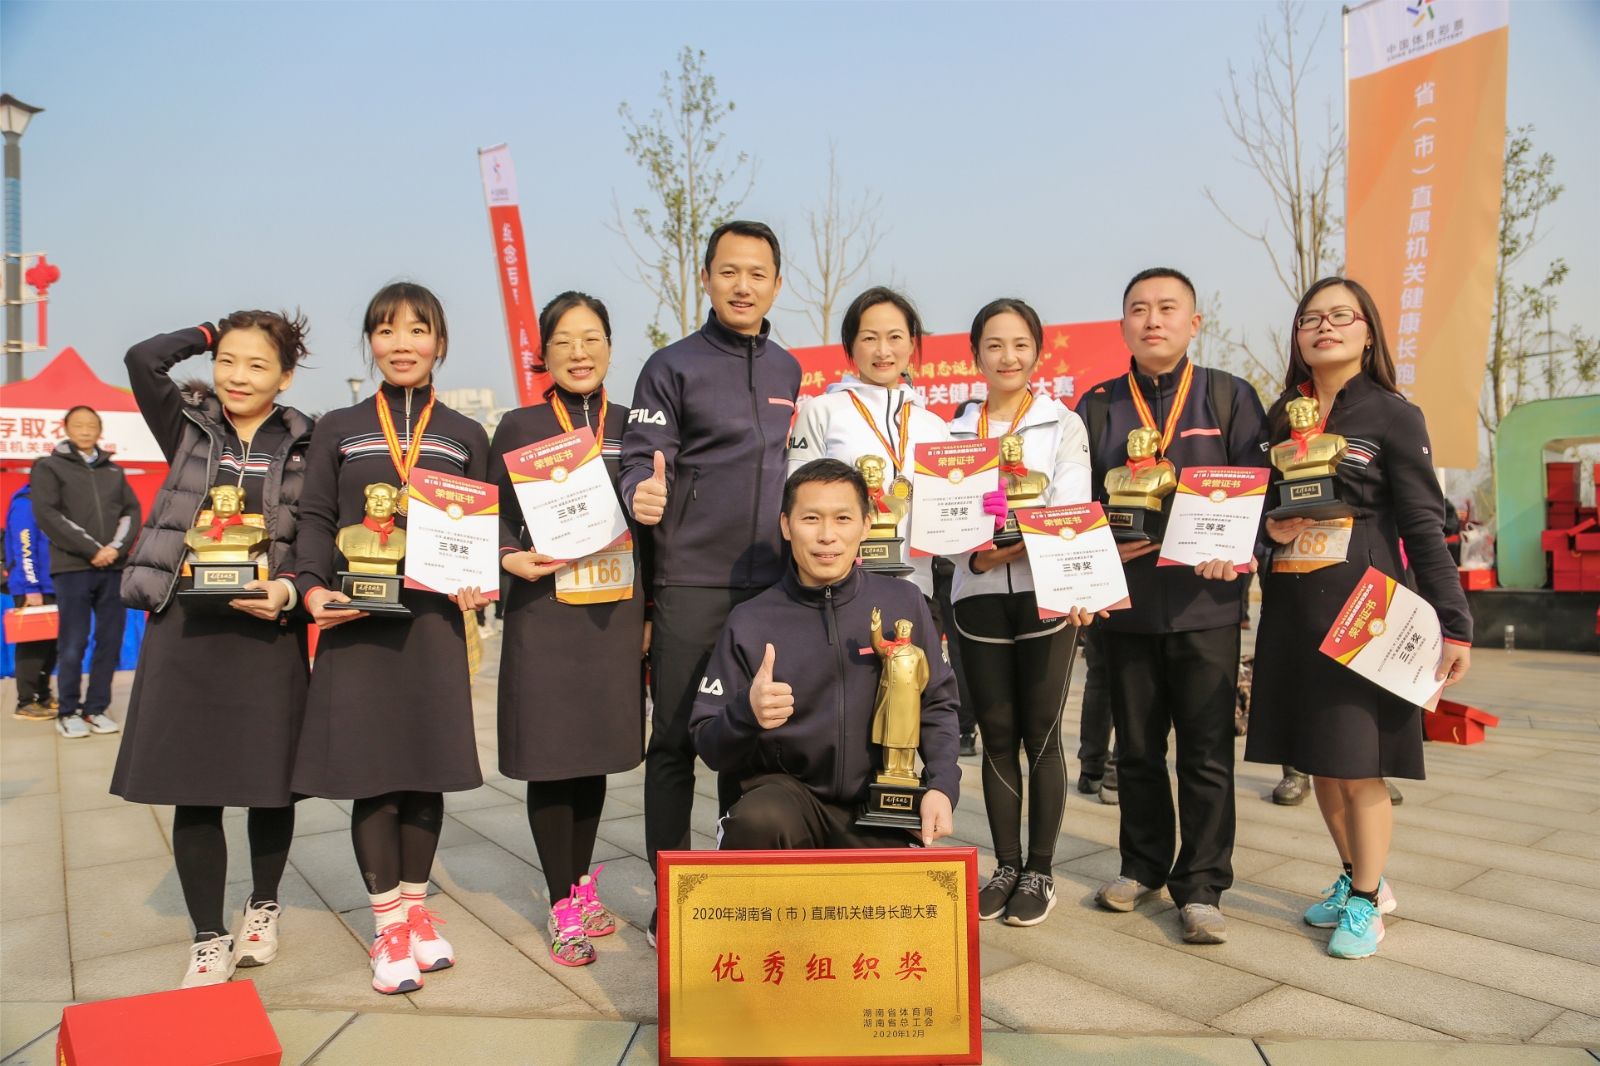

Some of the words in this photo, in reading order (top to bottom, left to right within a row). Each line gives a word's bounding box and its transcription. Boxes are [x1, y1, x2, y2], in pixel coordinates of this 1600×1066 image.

[627, 408, 667, 426] FILA
[789, 436, 809, 449] ILA
[556, 502, 588, 519] 三等奖
[940, 507, 969, 517] 三等奖
[1195, 523, 1226, 532] 三等奖
[438, 542, 470, 555] 三等奖
[570, 557, 622, 586] 1166
[1062, 561, 1092, 572] 三等奖
[1398, 632, 1422, 663] 三等奖
[698, 676, 724, 696] LA
[692, 904, 938, 922] 2020年湖南省（市）直属机关健身长跑大赛
[711, 950, 928, 986] 优秀组织奖
[863, 1006, 934, 1018] 湖南省体育局
[863, 1017, 934, 1029] 湖南省总工会
[873, 1029, 925, 1039] 2020年12月
